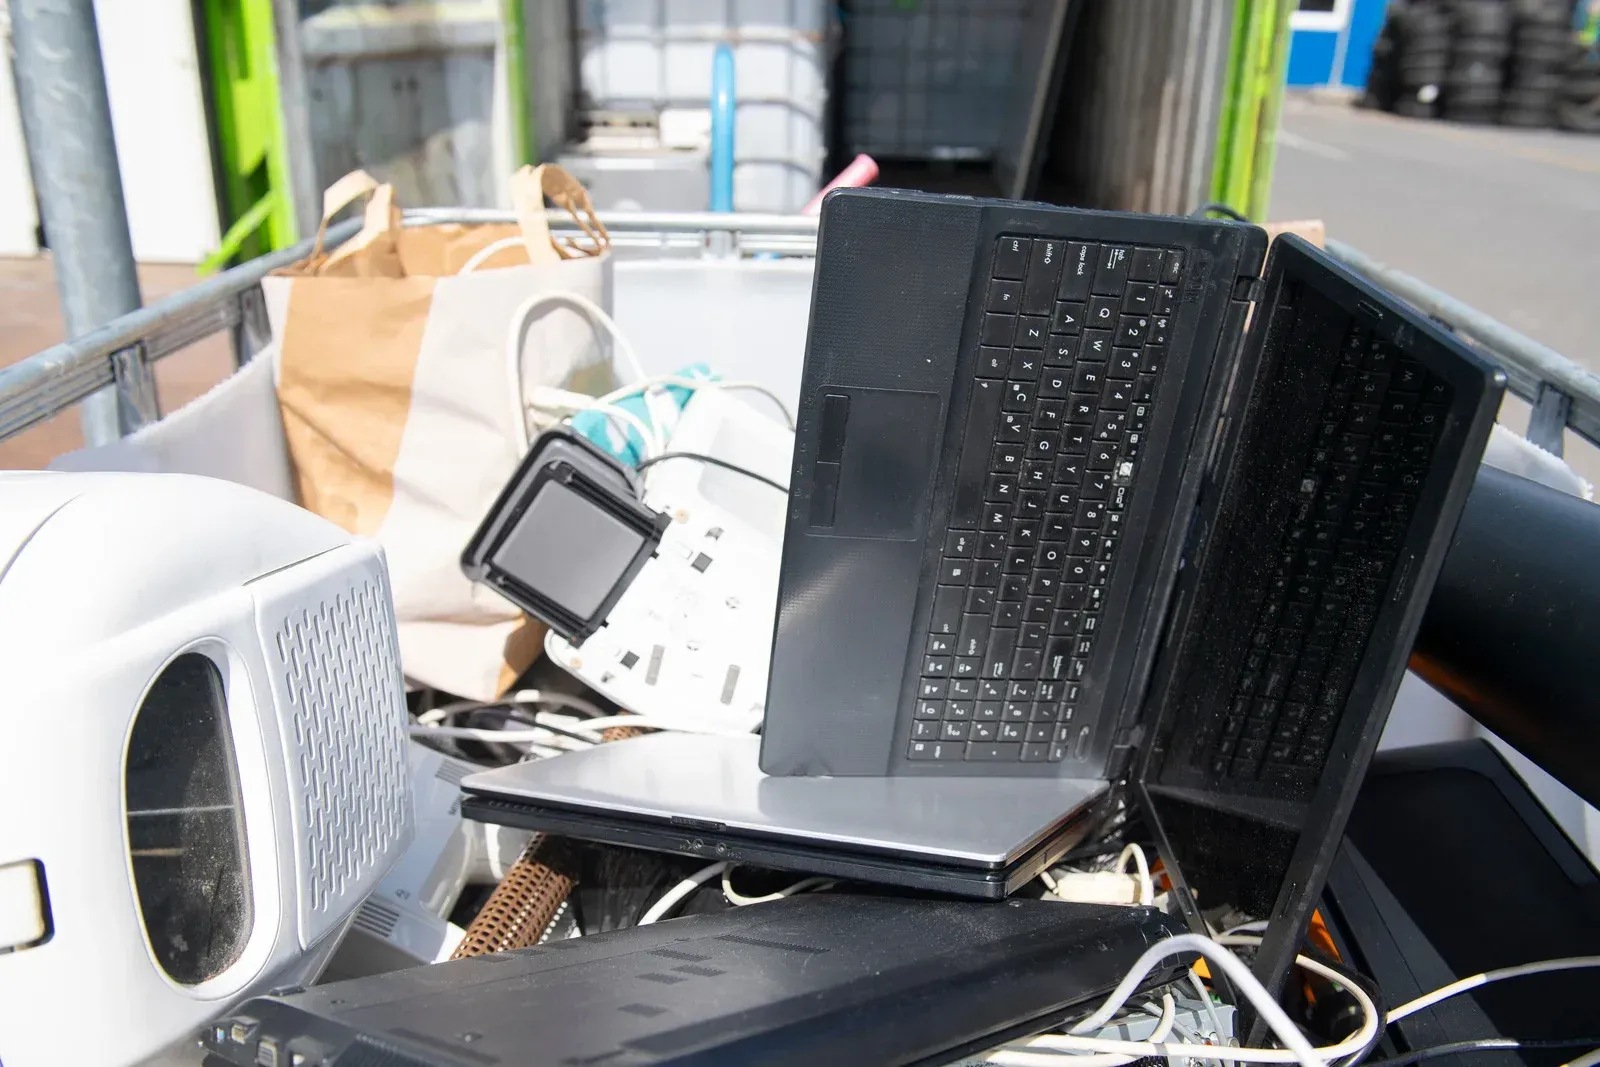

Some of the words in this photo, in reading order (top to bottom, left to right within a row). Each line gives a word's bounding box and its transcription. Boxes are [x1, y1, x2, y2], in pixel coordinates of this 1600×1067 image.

[1077, 262, 1085, 275] lock
[1099, 308, 1110, 318] Q
[1065, 315, 1074, 323] A
[1029, 329, 1039, 337] Z
[1128, 328, 1138, 336] 2
[1093, 340, 1103, 351] W
[1121, 360, 1131, 368] 3
[1052, 380, 1062, 388] D
[1017, 393, 1026, 401] C
[1039, 441, 1049, 450] G
[1033, 471, 1043, 480] H
[999, 484, 1009, 493] N
[1060, 495, 1069, 503] U
[993, 513, 1002, 522] M
[1021, 529, 1031, 537] K
